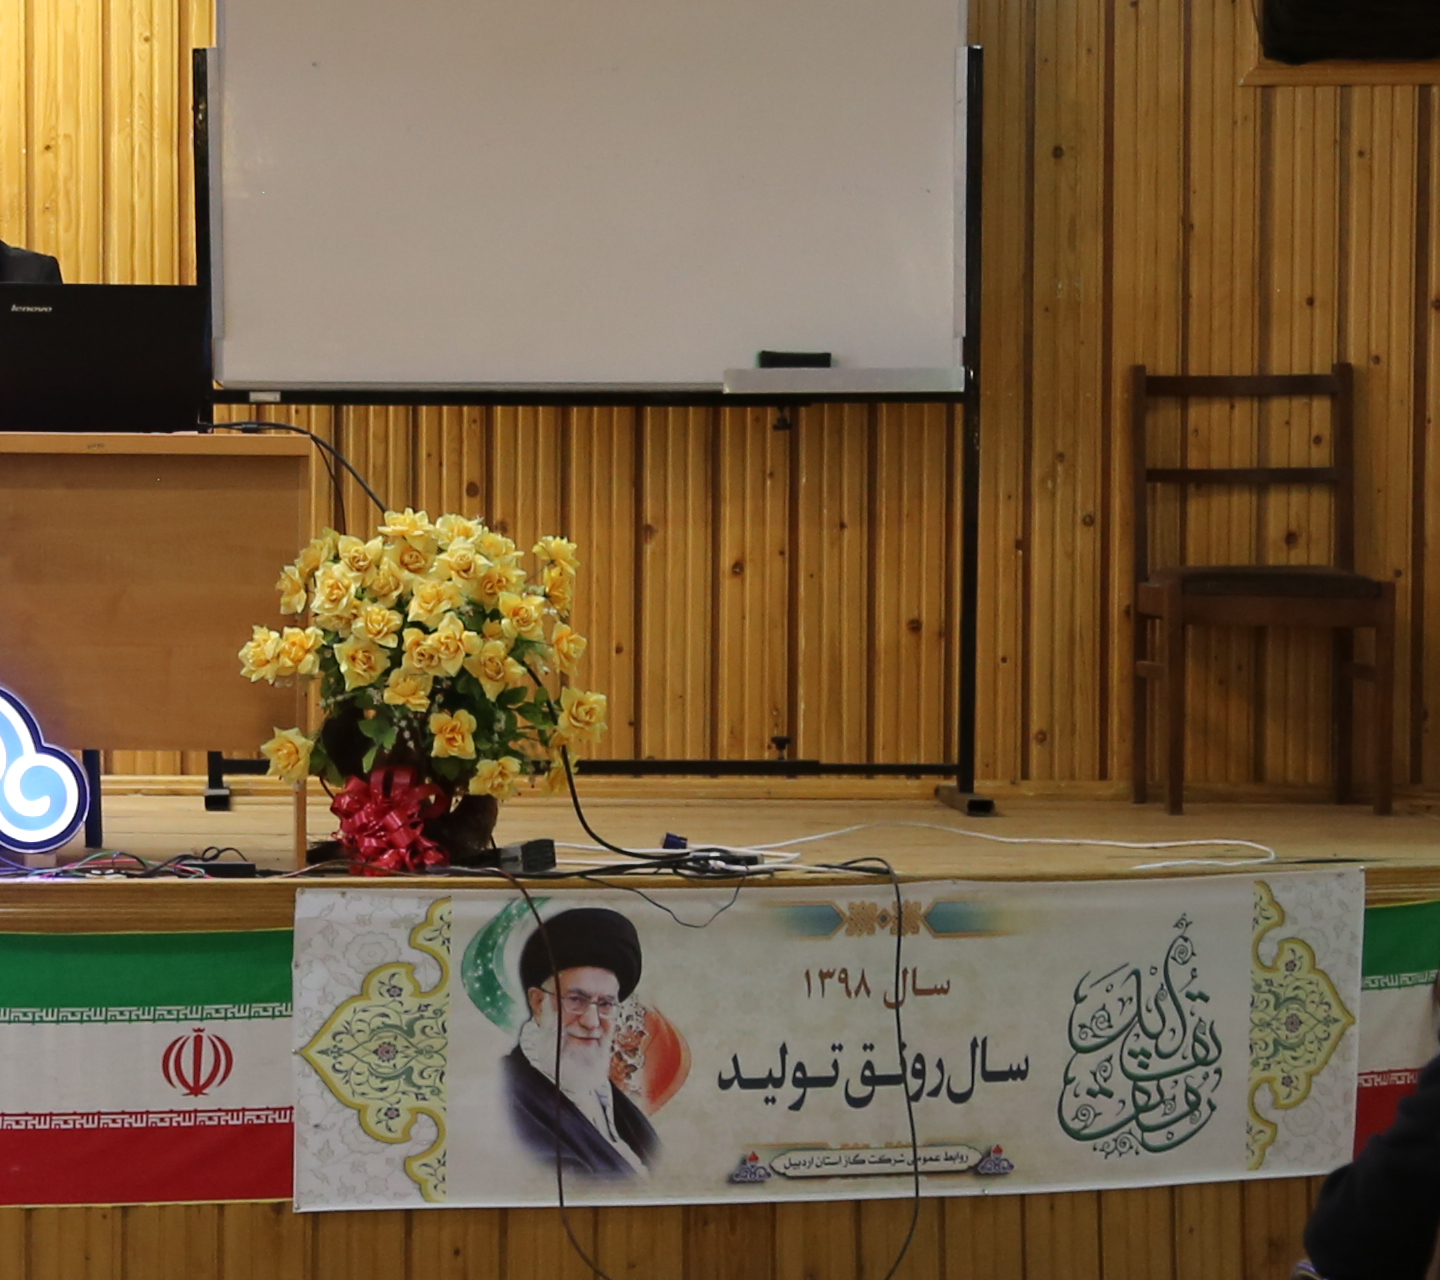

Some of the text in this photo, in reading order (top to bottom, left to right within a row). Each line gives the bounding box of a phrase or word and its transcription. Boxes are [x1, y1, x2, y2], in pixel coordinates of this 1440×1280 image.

[804, 966, 951, 1009] سال ۱۳۹۸
[717, 1035, 1030, 1111] سال رونق تولید
